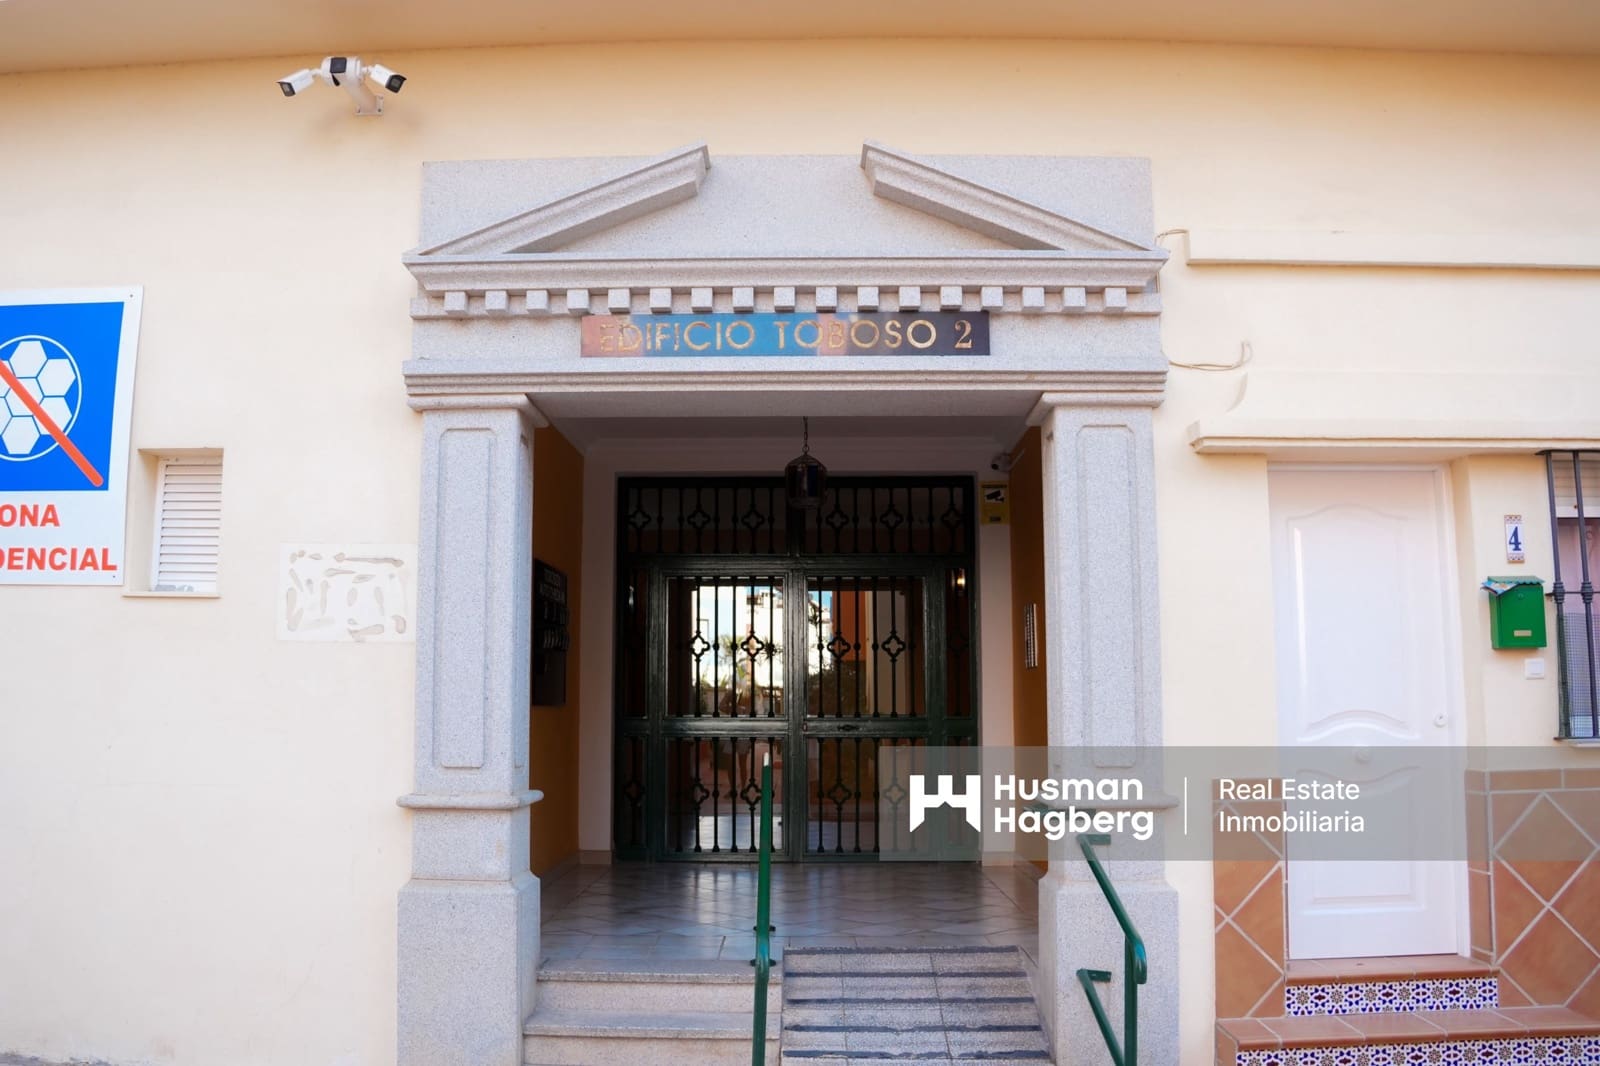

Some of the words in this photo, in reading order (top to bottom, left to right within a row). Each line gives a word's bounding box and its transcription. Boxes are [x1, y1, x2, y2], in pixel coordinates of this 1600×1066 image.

[600, 320, 756, 350] EDIFICIO
[773, 319, 937, 349] TOBOSO
[954, 319, 973, 349] 2
[1508, 526, 1523, 552] 4
[0, 547, 118, 571] ENCIAL
